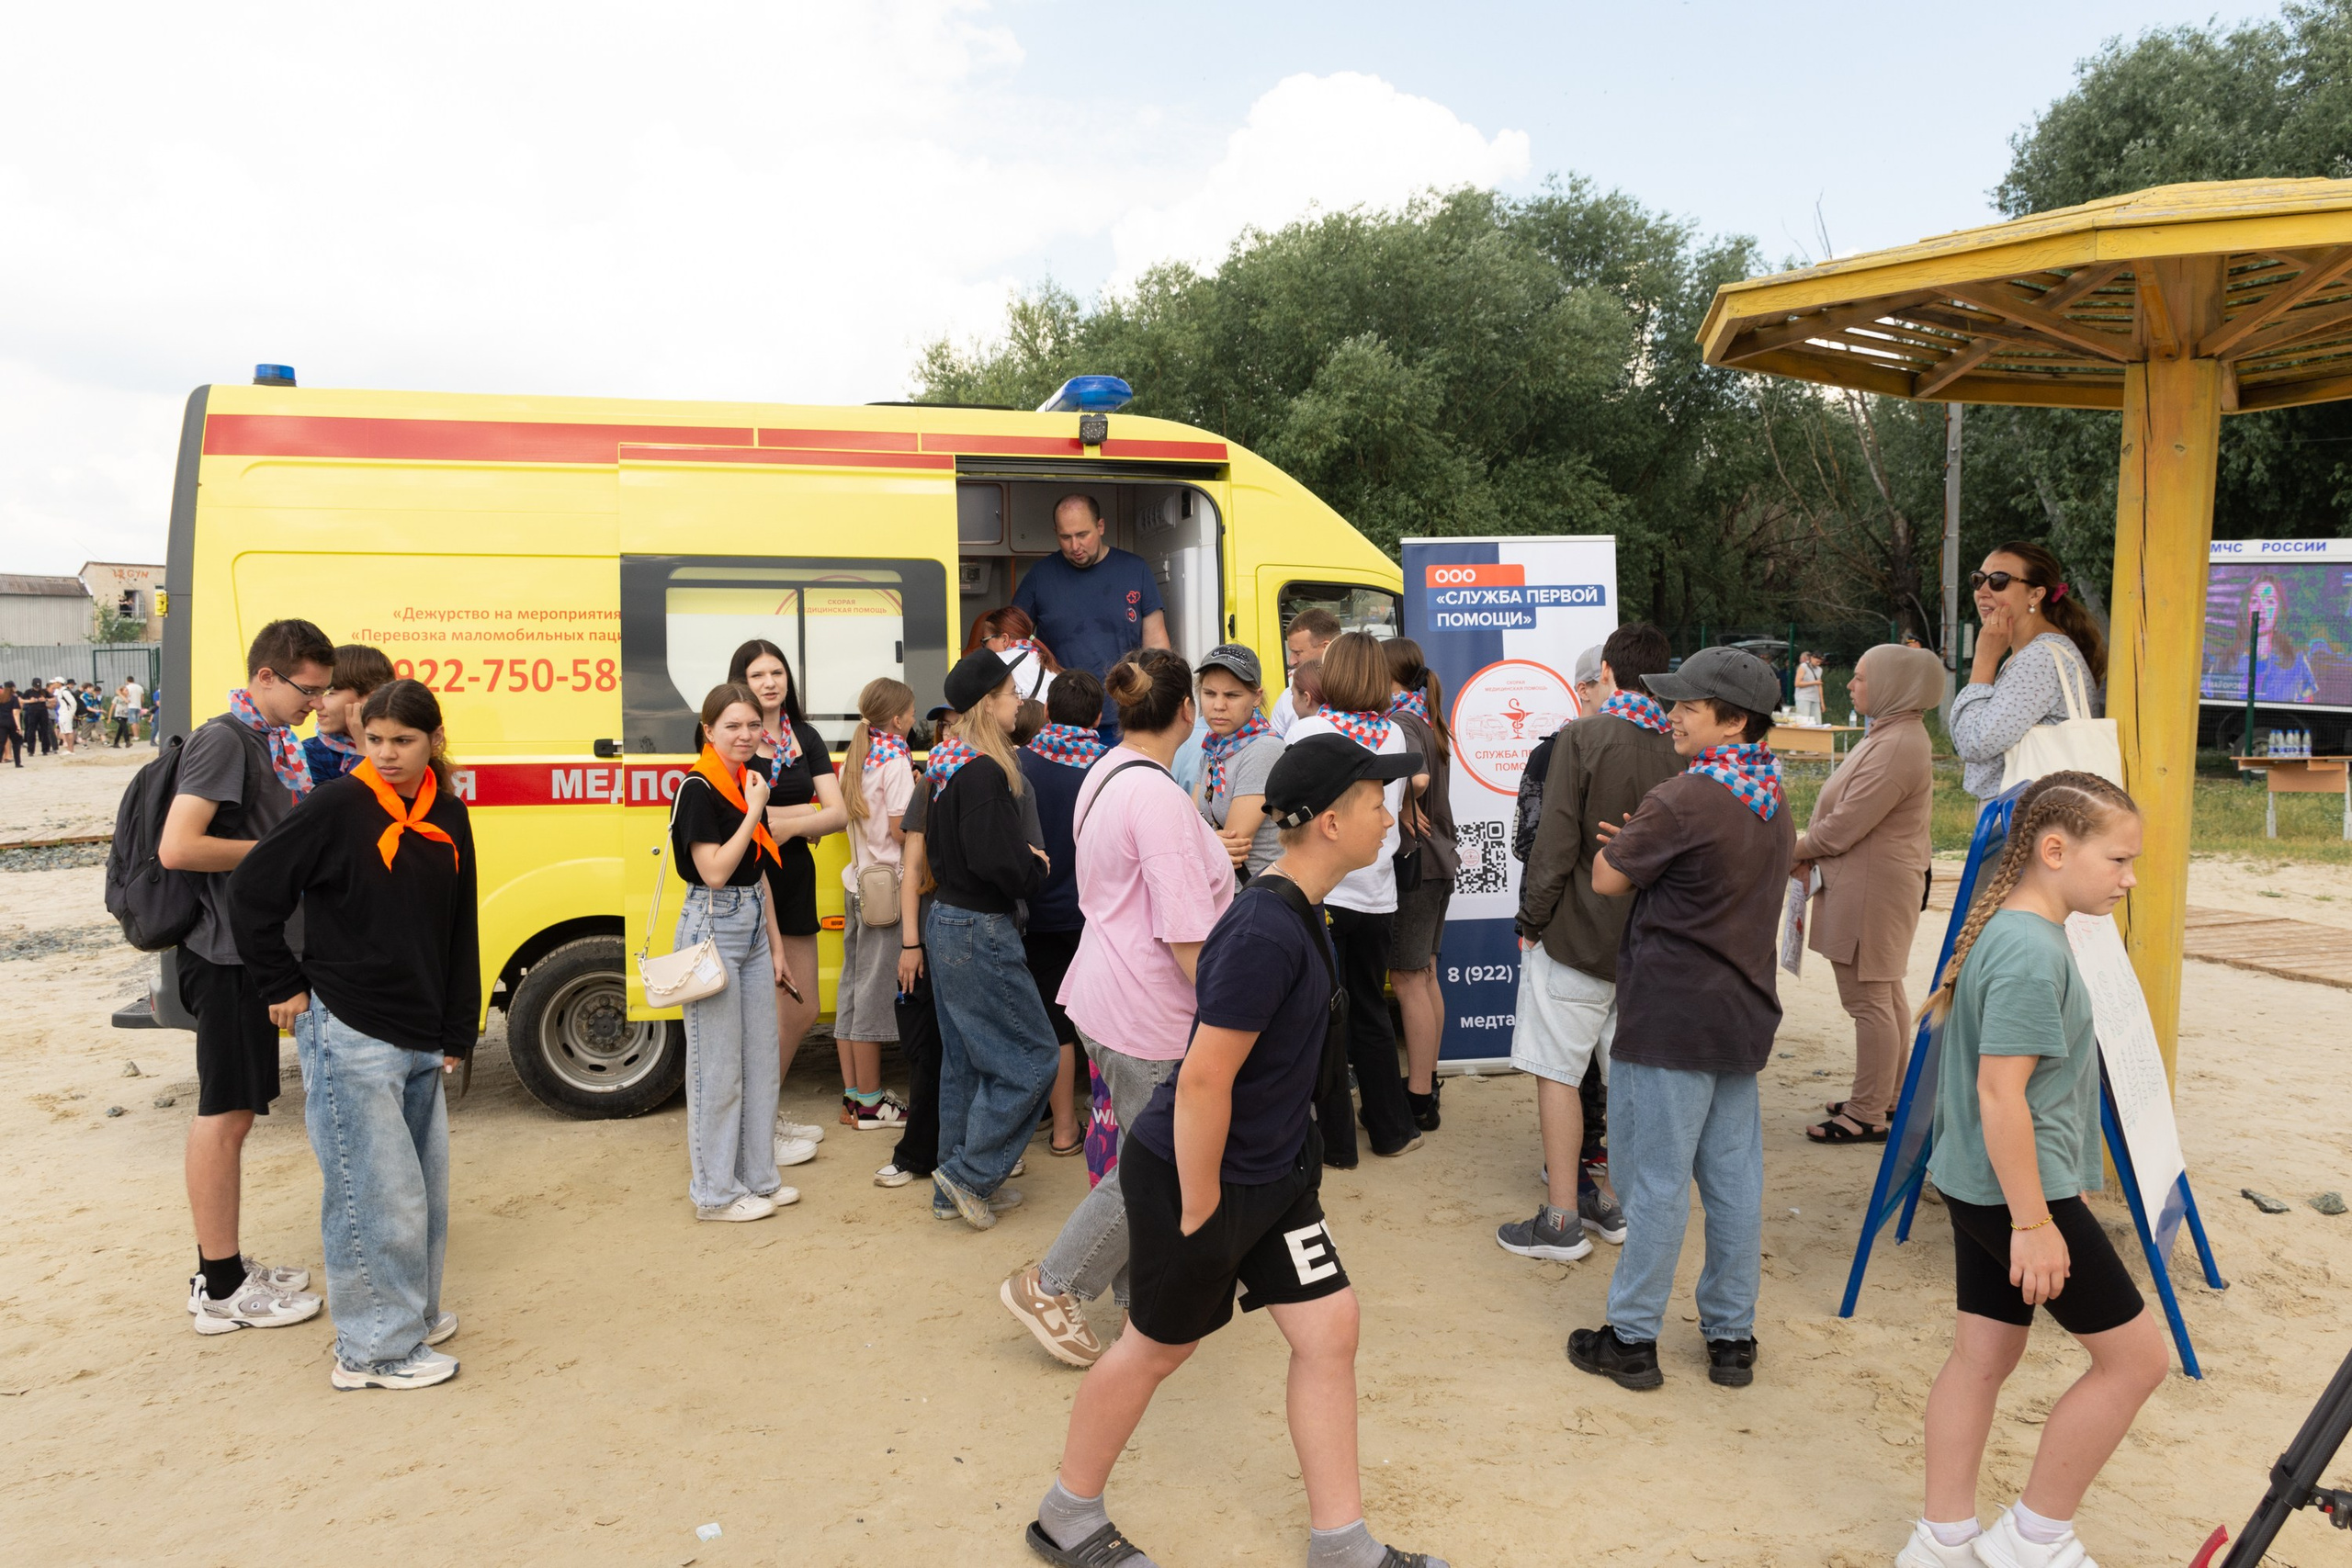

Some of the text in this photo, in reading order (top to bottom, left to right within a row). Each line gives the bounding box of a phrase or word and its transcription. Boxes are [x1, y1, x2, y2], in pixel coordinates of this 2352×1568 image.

[2210, 542, 2327, 553] МЧС РОССИИ
[1435, 569, 1476, 583] ООО
[1436, 585, 1599, 605] «СЛУЖБА ПЕРВОЙ
[393, 607, 490, 623] «Дежурство
[494, 610, 514, 620] на
[1437, 611, 1532, 627] ПОМОЩИ»
[351, 628, 447, 644] «Перевозка
[451, 628, 584, 642] маломобильных
[393, 658, 623, 693] 922-750-58
[1475, 750, 1519, 760] СЛУЖБА
[1447, 964, 1513, 986] 8 (922)
[1460, 1013, 1516, 1030] медта
